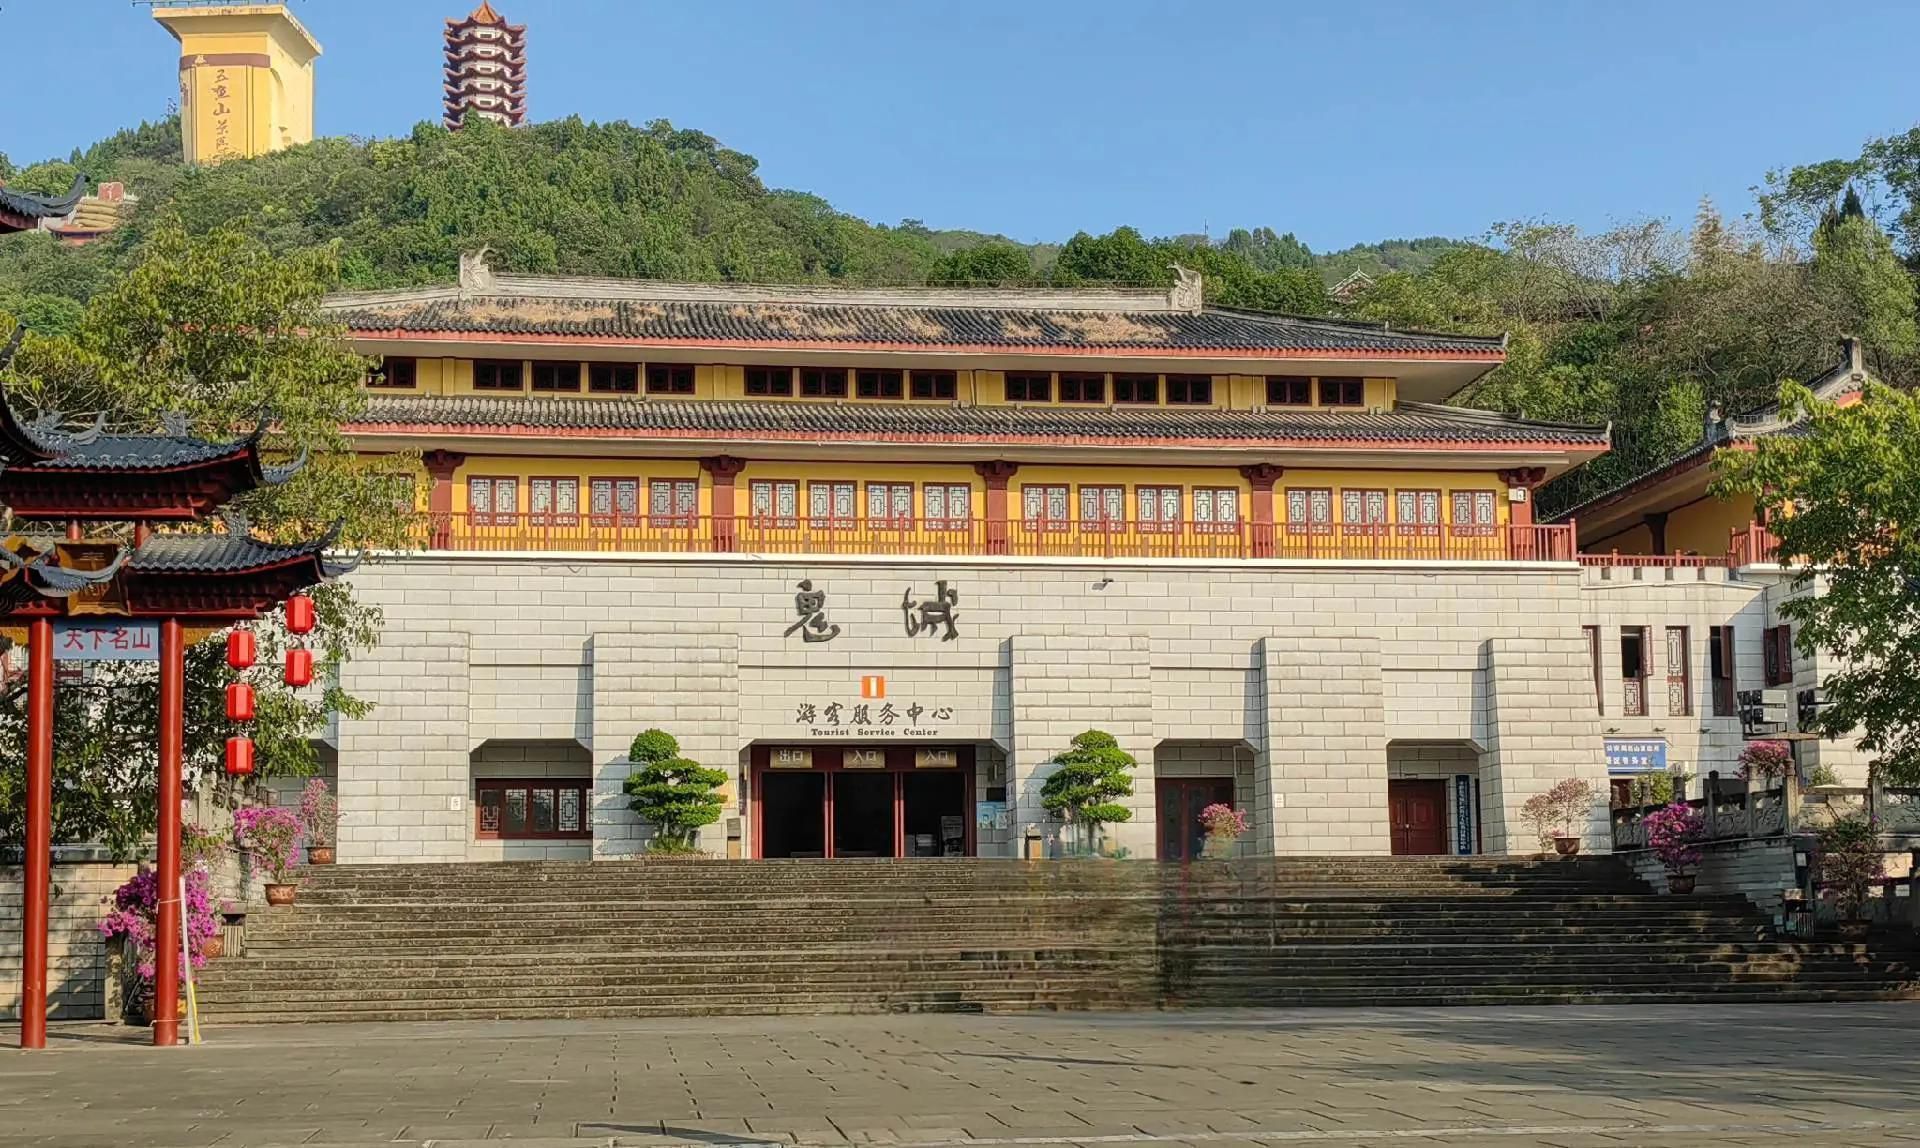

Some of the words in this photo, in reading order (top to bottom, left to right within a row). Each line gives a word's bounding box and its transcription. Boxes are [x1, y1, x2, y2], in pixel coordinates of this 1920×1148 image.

[784, 578, 960, 643] 鬼城
[63, 626, 151, 651] 天下名山
[796, 701, 954, 727] 游客服务中心
[811, 728, 849, 736] Tourist
[857, 728, 896, 736] Service
[903, 728, 939, 736] Center
[779, 749, 803, 762] 出口
[853, 749, 877, 762] 入口
[925, 749, 948, 761] 入口
